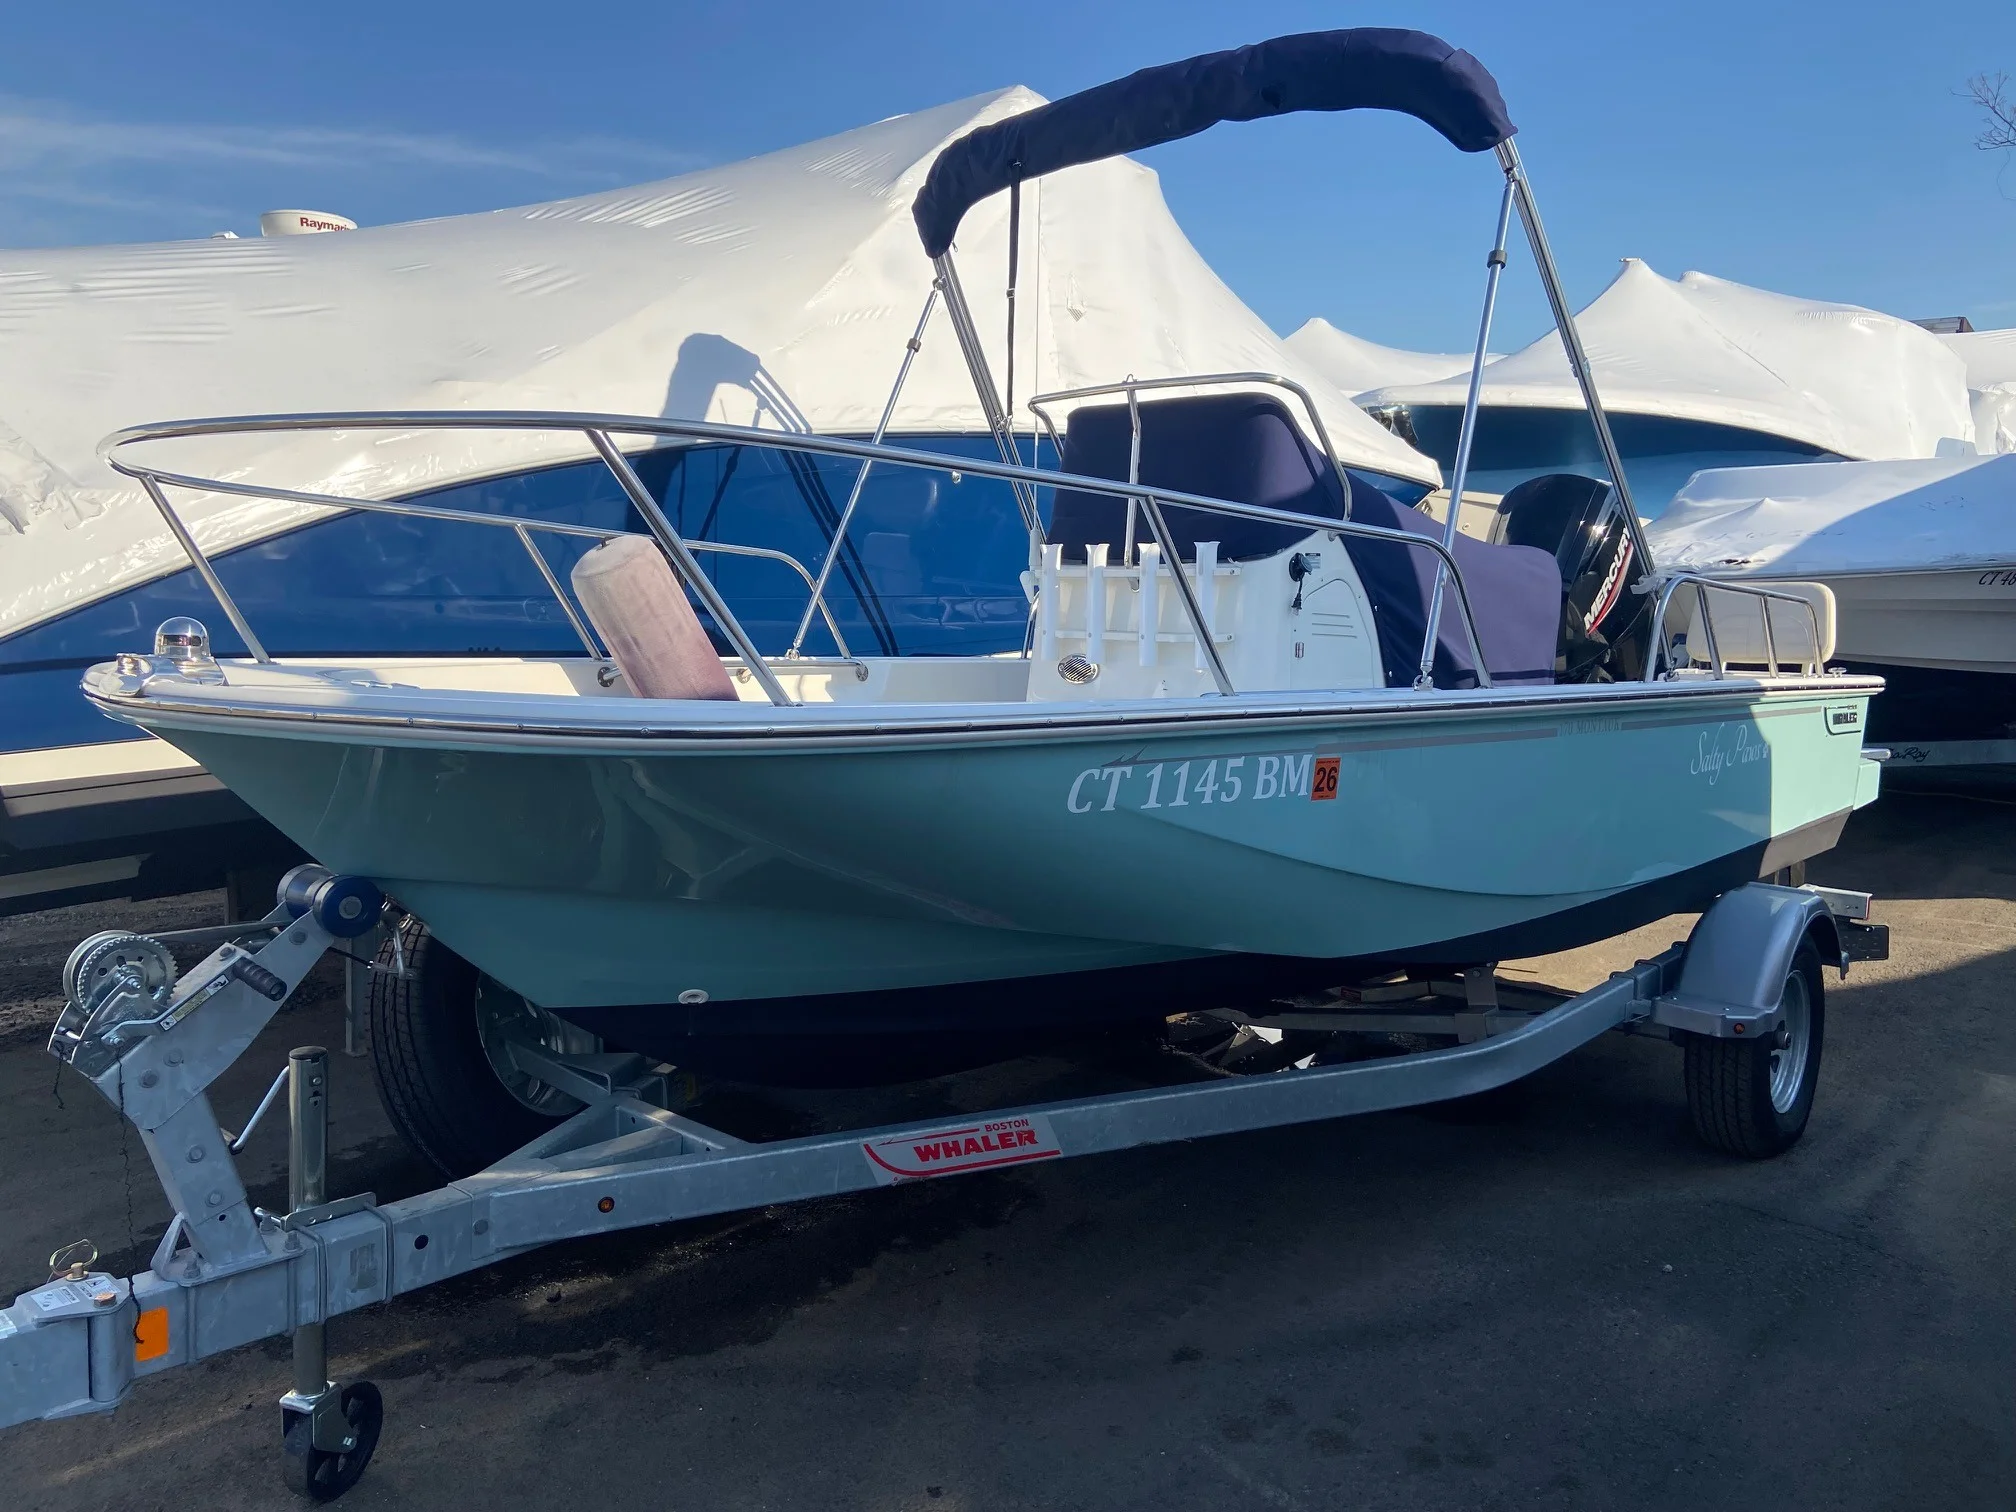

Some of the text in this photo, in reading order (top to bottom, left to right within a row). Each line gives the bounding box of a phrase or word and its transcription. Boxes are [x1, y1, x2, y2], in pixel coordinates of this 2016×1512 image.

[1979, 571, 2003, 586] CT
[1691, 721, 1762, 785] Salty Paws
[1902, 746, 1931, 763] Ray
[1067, 754, 1314, 814] CT 1145 BM
[1313, 766, 1337, 793] 26
[984, 1118, 1030, 1132] BOSTON
[913, 1129, 1039, 1163] WHALER
